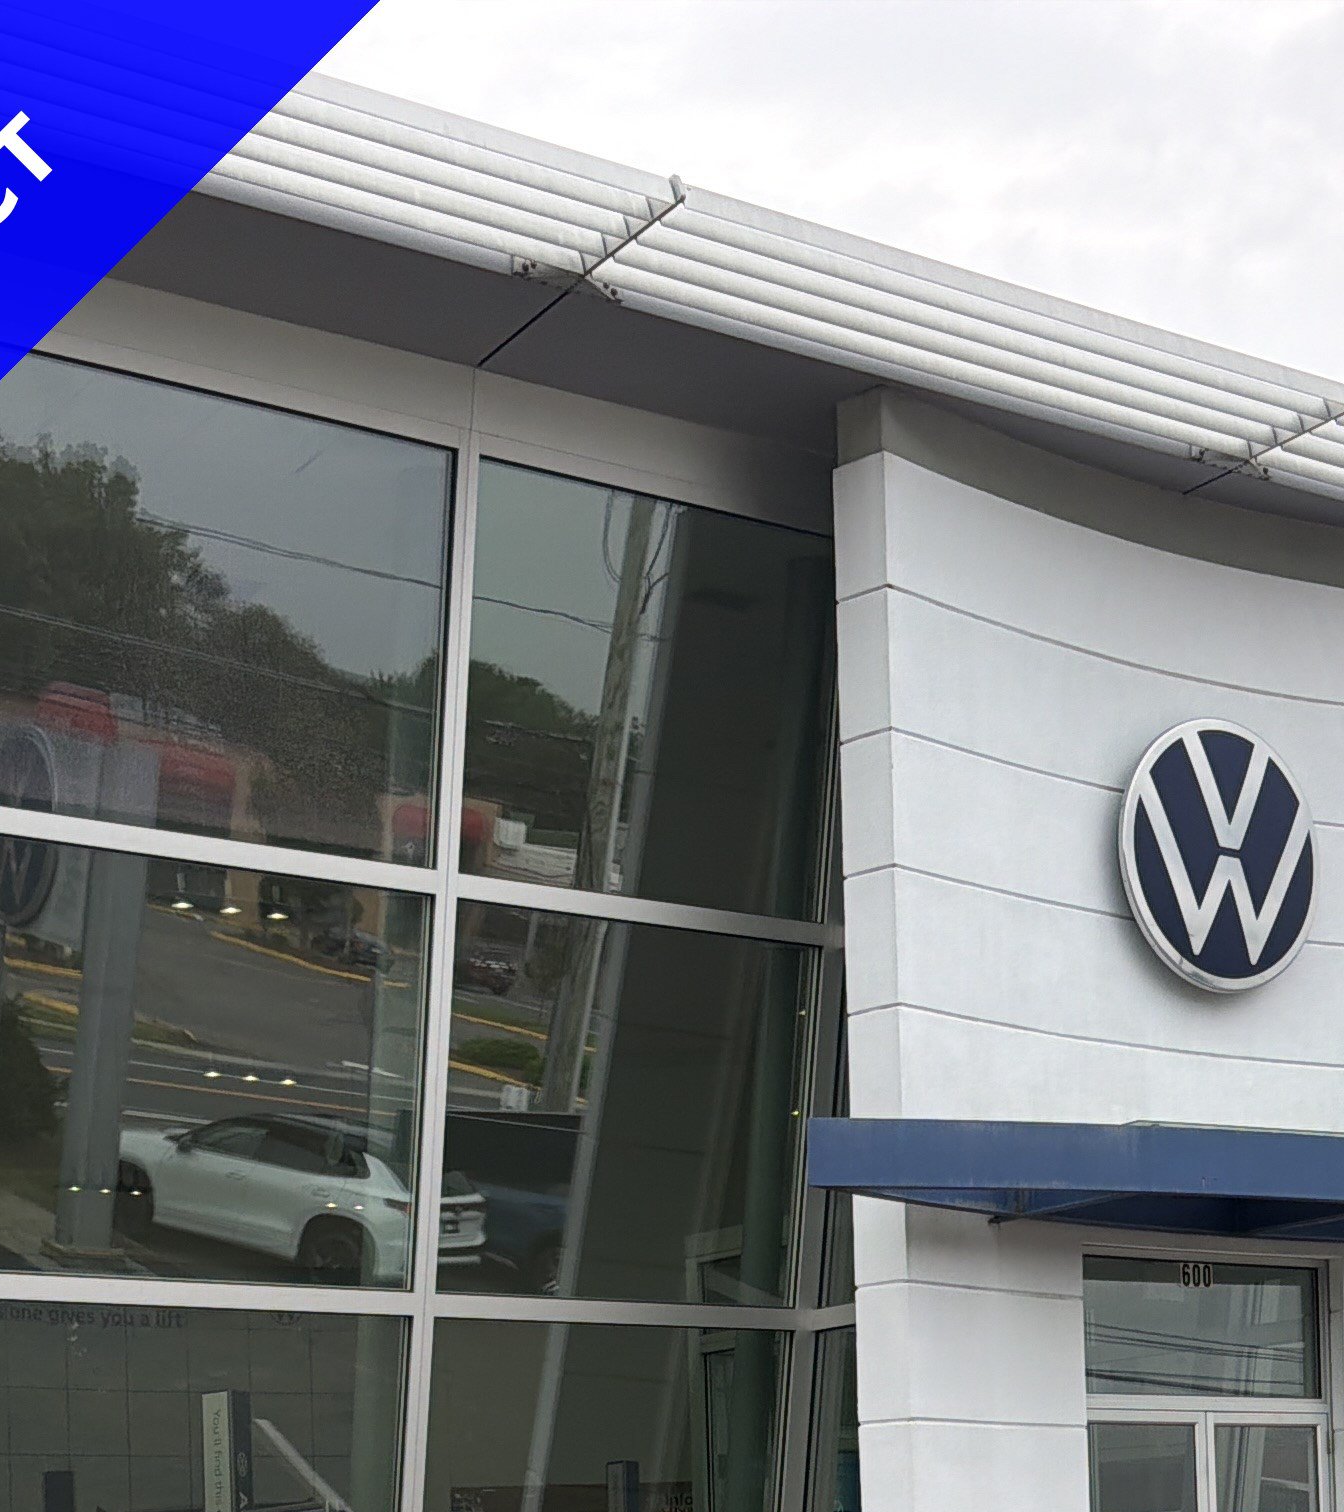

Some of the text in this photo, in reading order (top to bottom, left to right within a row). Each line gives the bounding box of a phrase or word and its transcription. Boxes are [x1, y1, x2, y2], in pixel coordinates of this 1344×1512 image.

[1182, 1263, 1211, 1287] 600
[49, 1307, 95, 1327] gives
[102, 1312, 135, 1329] you
